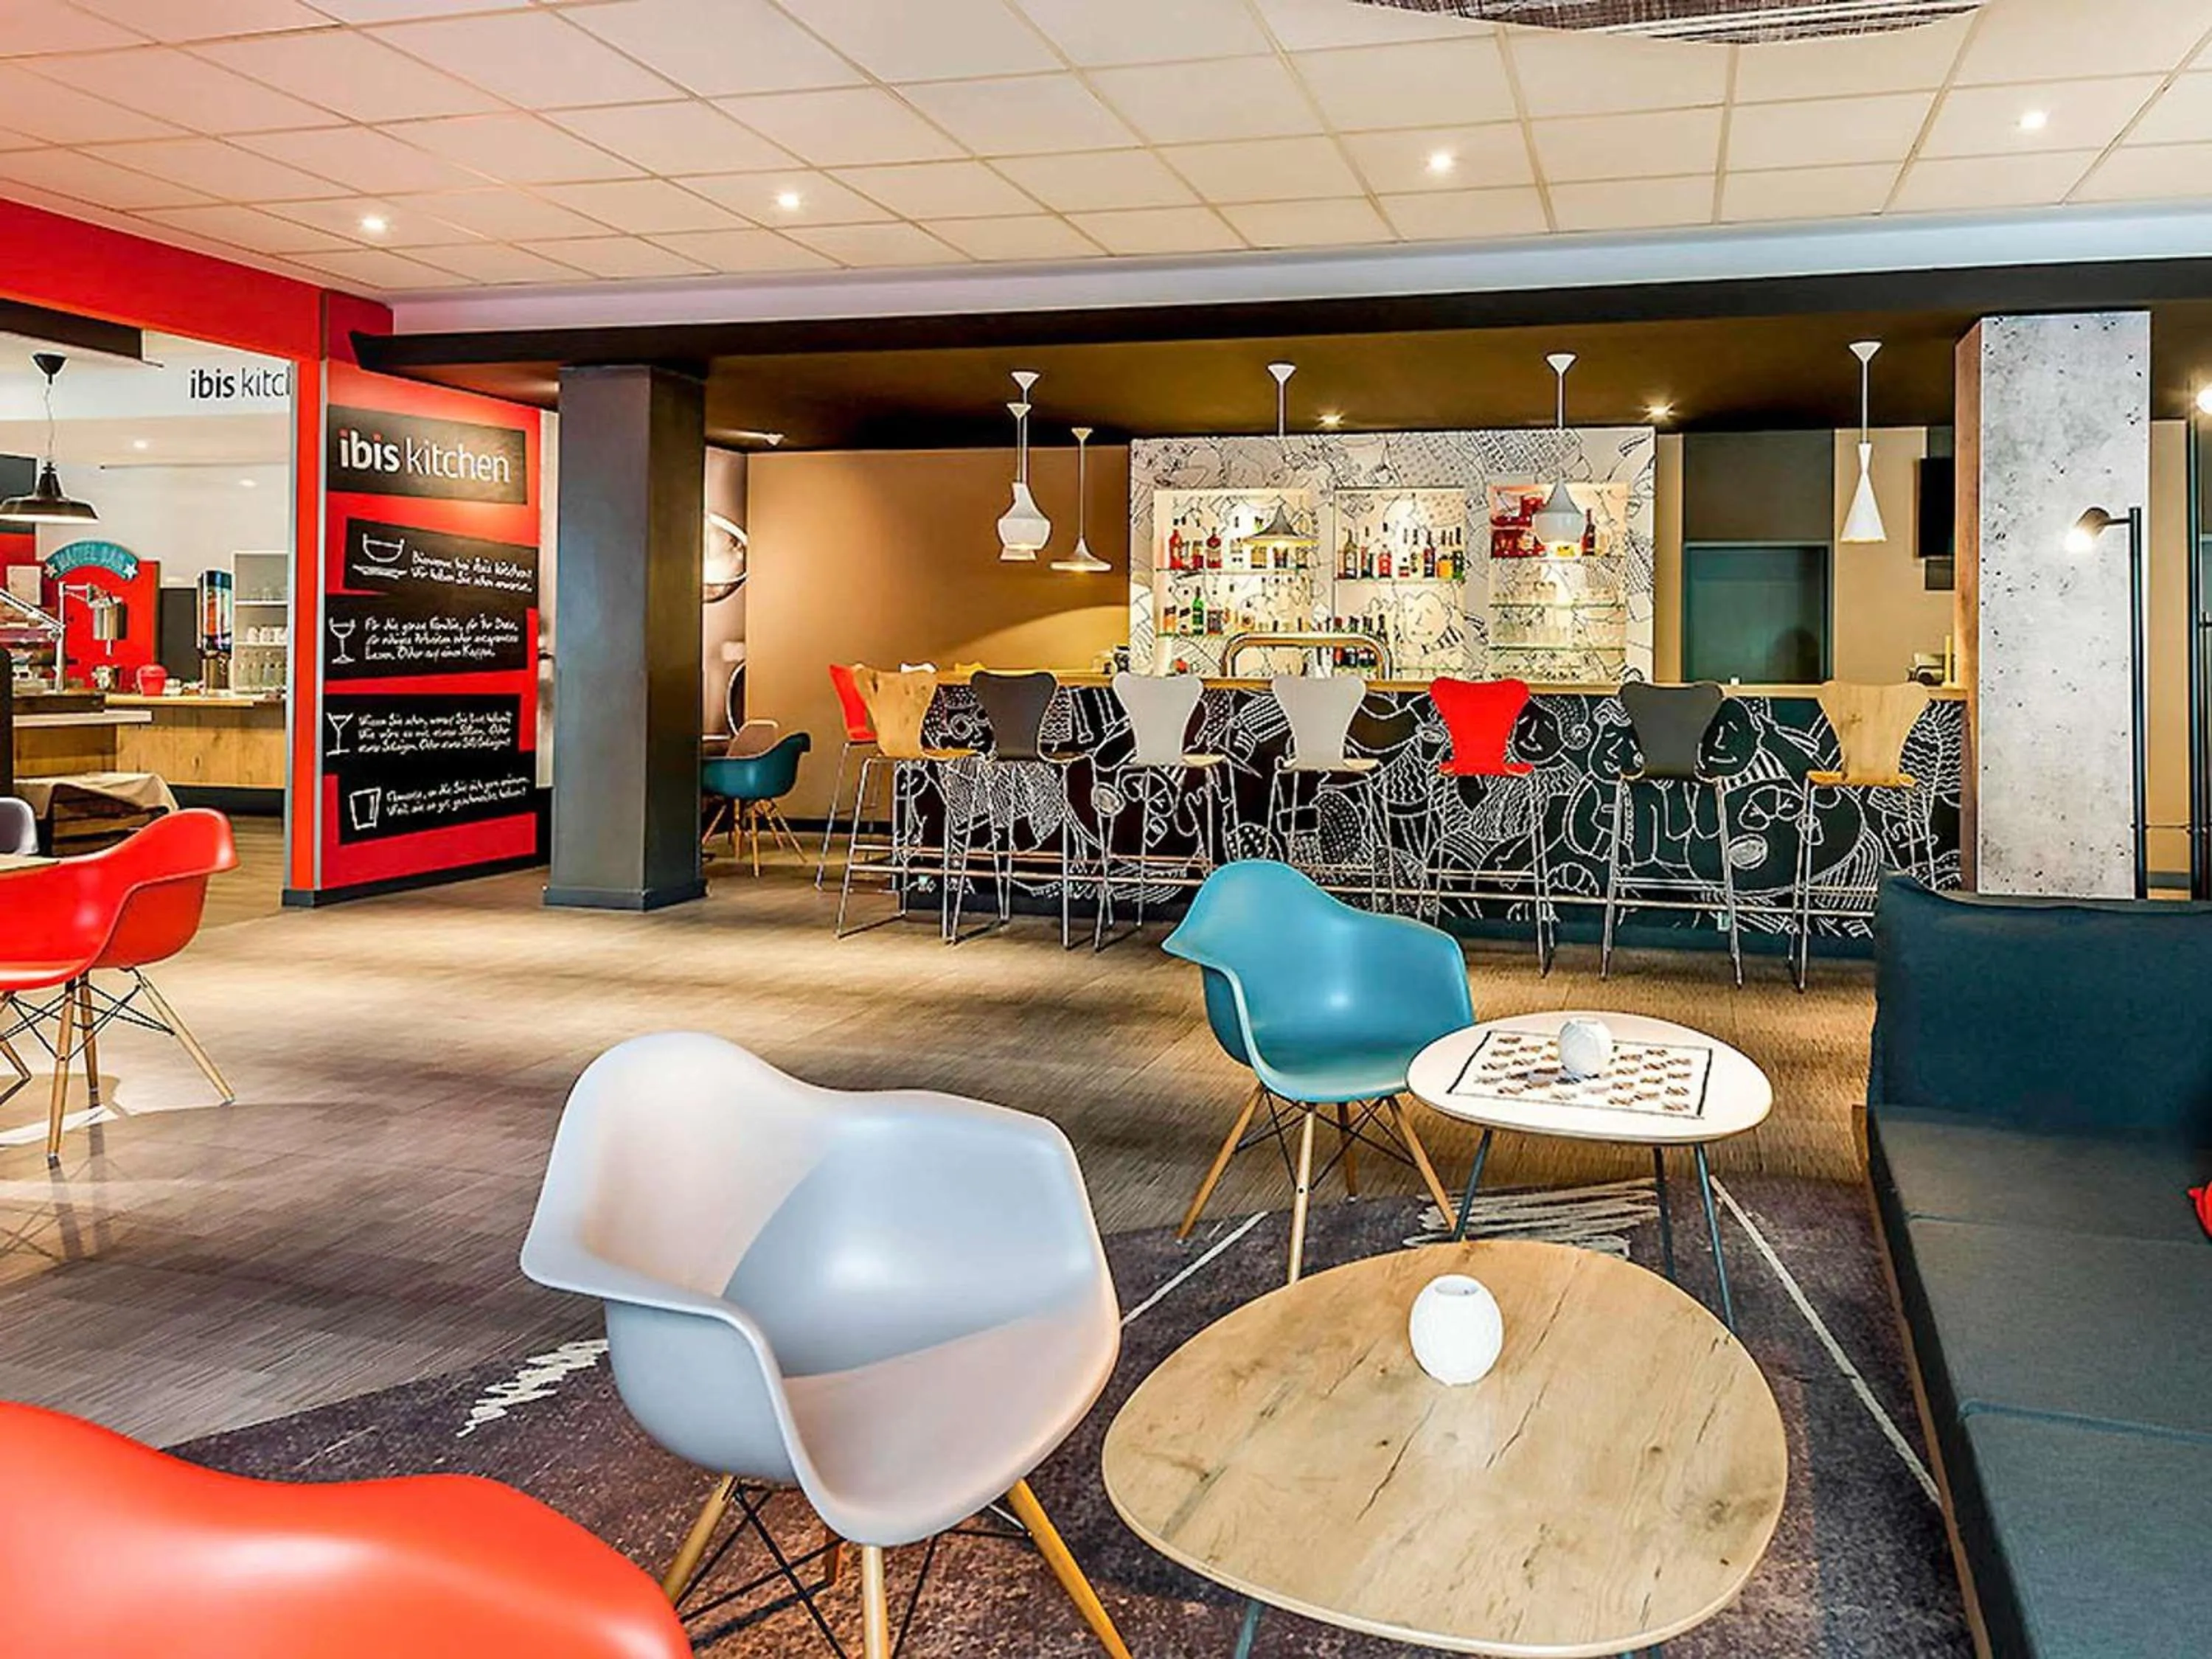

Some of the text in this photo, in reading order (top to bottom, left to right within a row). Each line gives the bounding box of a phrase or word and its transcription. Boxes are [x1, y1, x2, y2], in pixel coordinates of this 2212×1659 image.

[191, 369, 235, 398] ibis
[338, 428, 510, 483] ibis kitchen
